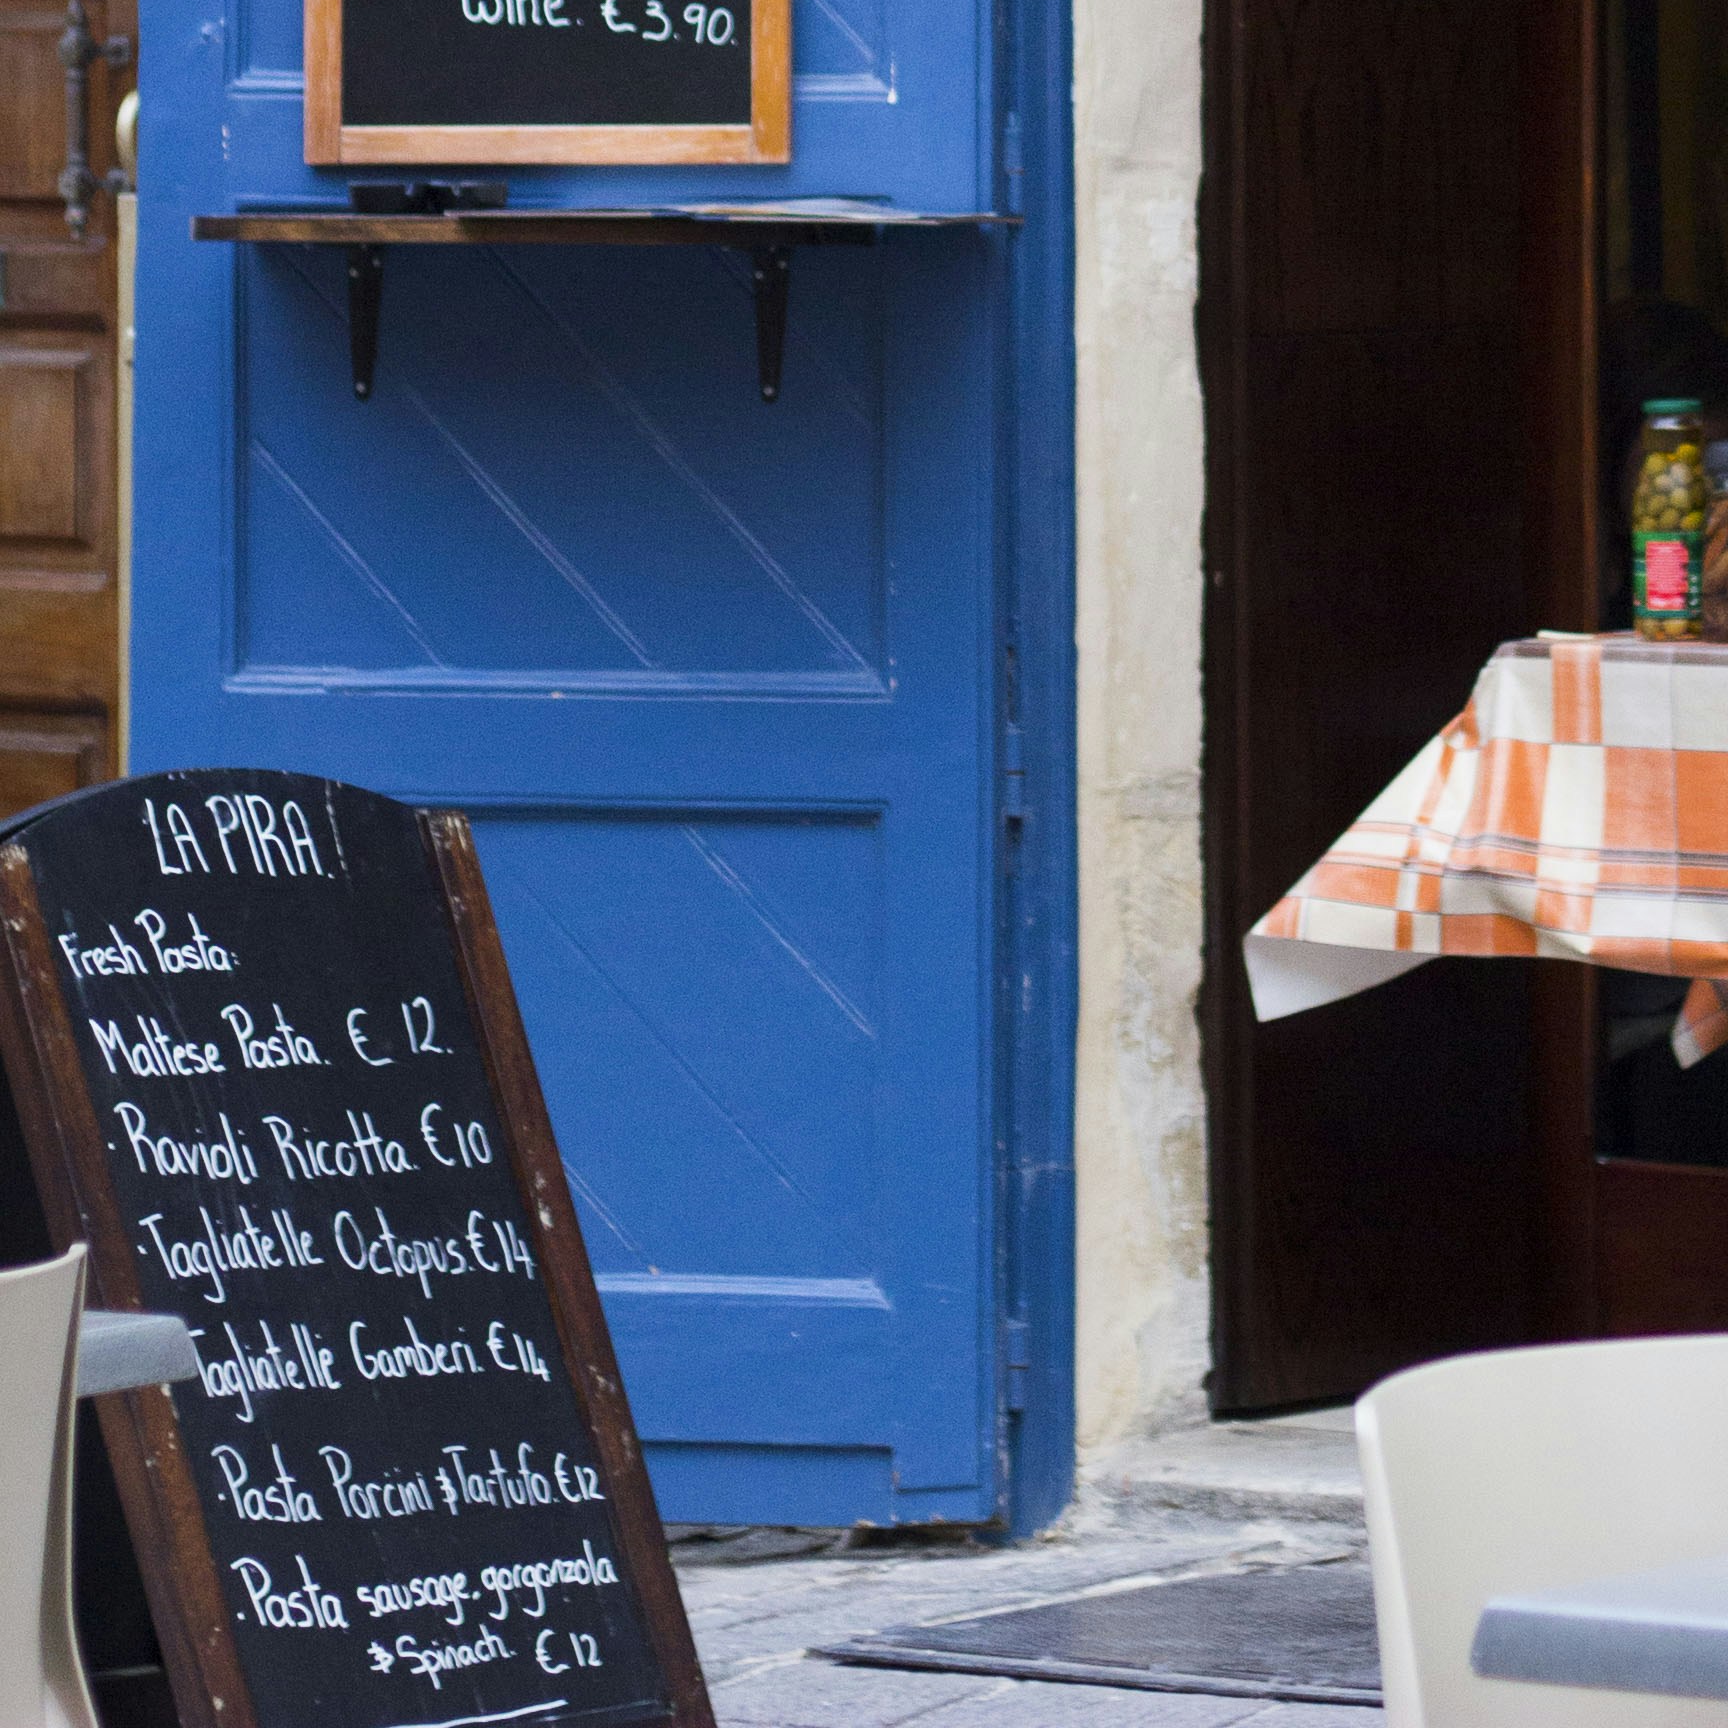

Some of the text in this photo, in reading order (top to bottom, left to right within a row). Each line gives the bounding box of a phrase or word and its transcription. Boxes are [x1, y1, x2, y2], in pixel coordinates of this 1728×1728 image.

[144, 797, 209, 875] LA
[58, 924, 148, 978] Fresh
[89, 1015, 226, 1076] Maltese
[113, 1101, 258, 1184] Ravioli
[139, 1206, 324, 1304] Tagliatelle
[211, 1442, 323, 1523] Pasta
[318, 1445, 435, 1519] Porcini
[230, 1553, 349, 1629] Pasta
